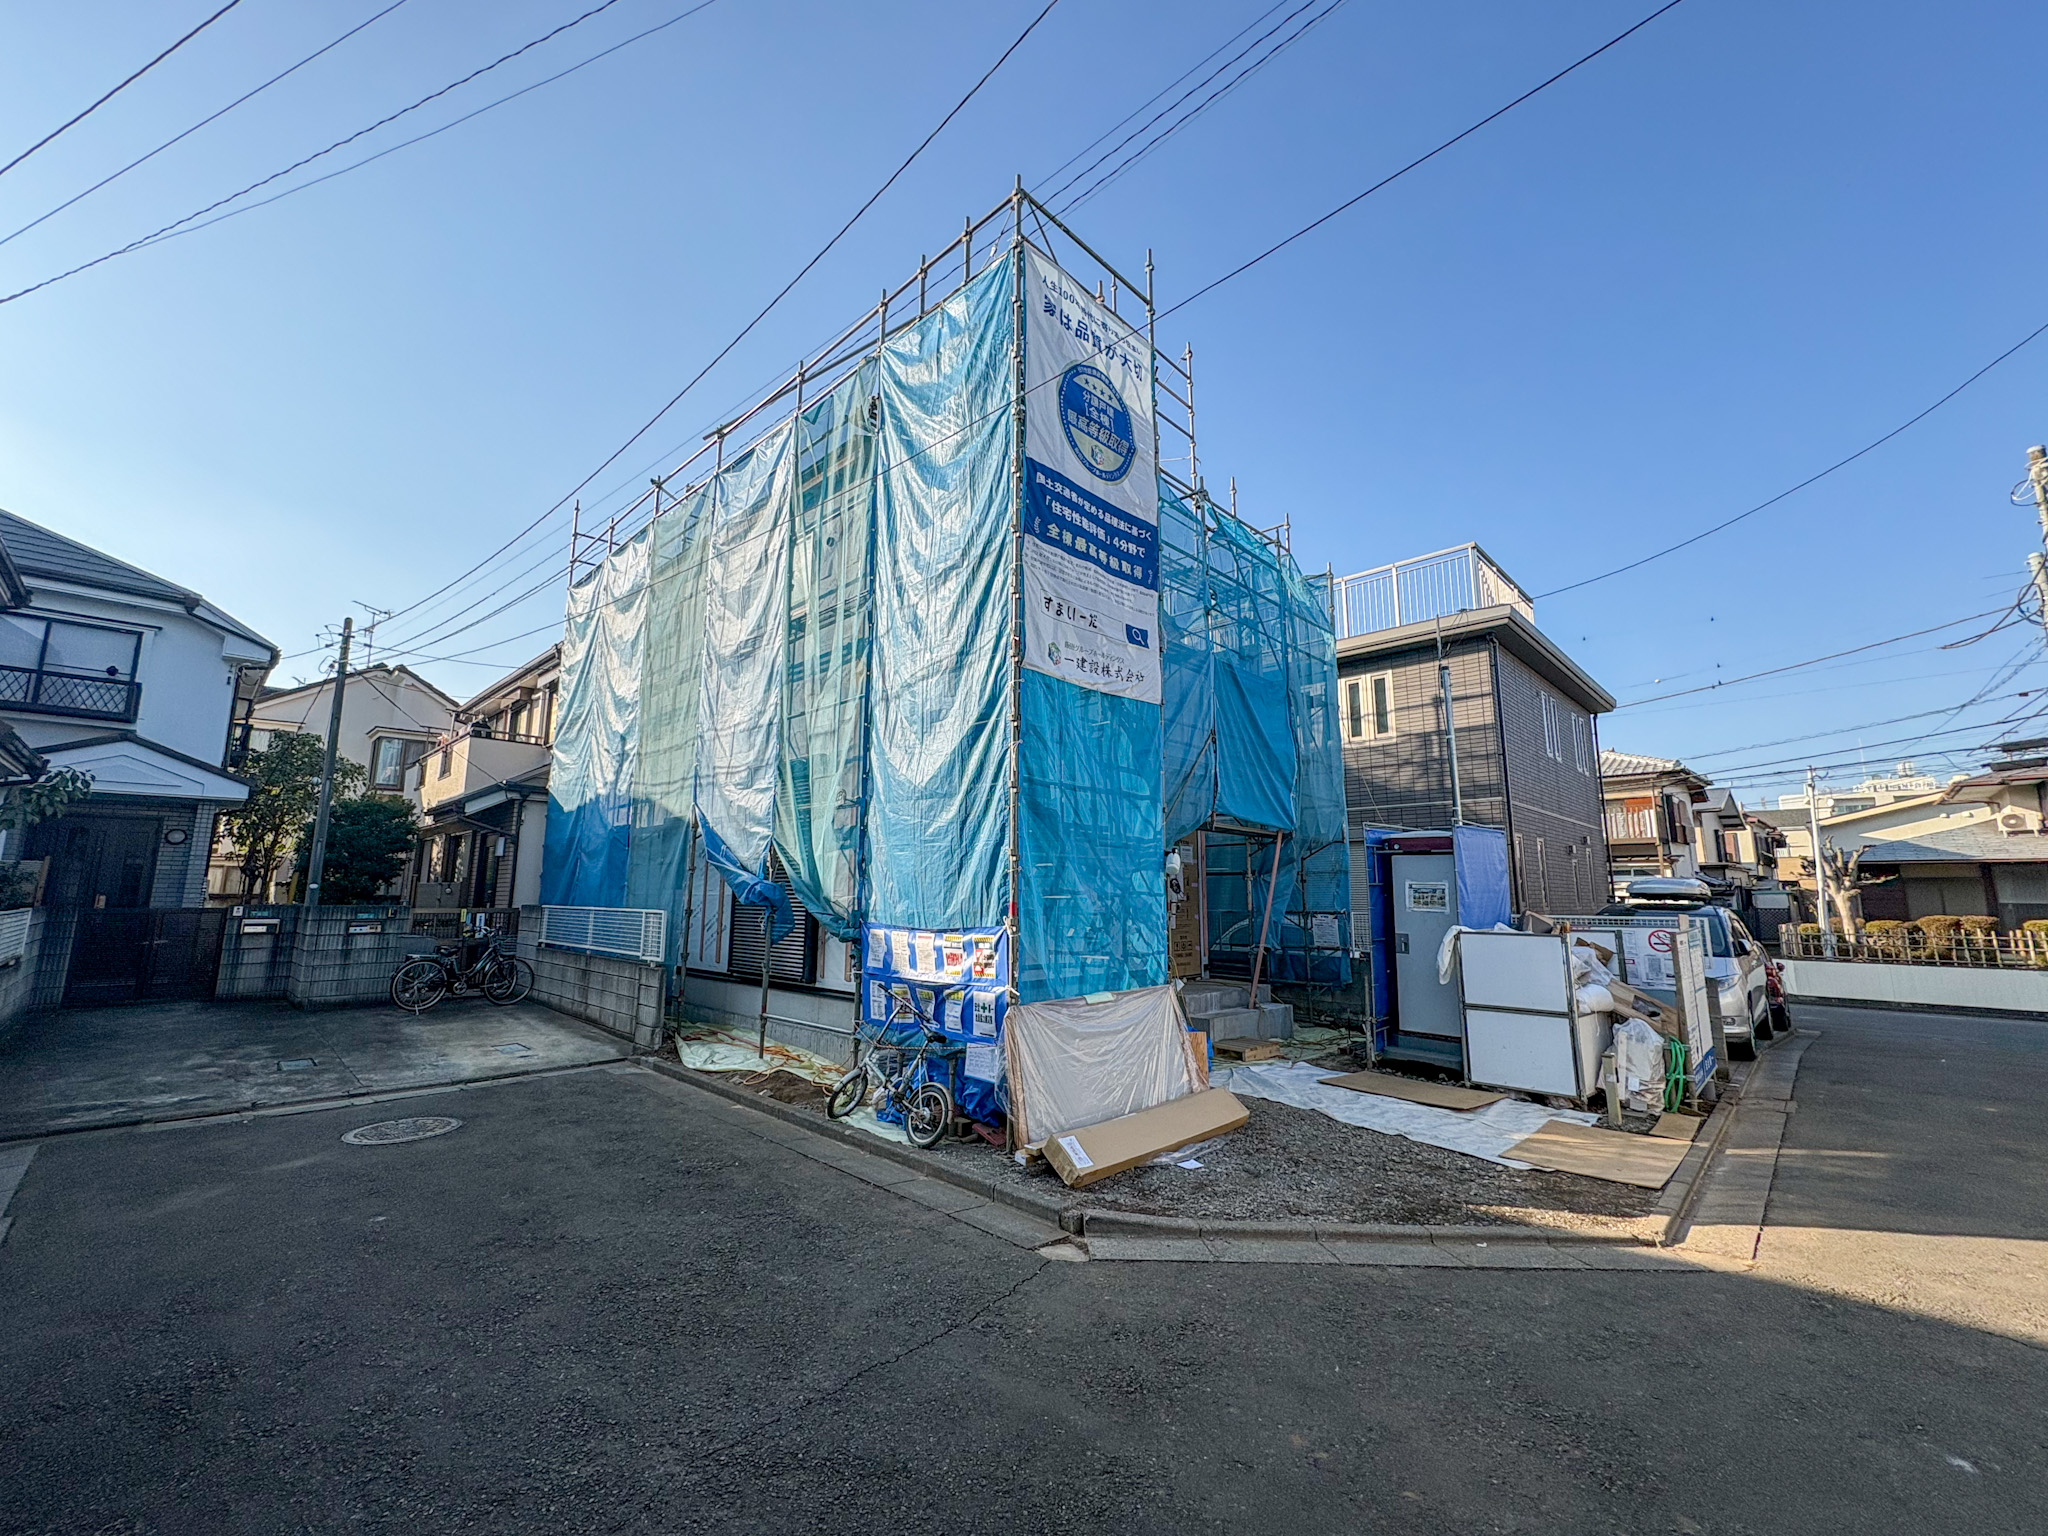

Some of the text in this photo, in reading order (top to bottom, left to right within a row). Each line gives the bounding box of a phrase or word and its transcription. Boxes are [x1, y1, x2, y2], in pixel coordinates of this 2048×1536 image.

[1043, 294, 1142, 382] 家は品質が大切
[1067, 408, 1129, 456] 最高等級取得
[1036, 472, 1152, 541] 国土交通省が定める品確法に基づく
[1046, 523, 1143, 580] 全棟最高等級取得
[1043, 597, 1098, 629] すまいーだ
[1064, 656, 1145, 682] 一建設株式会社
